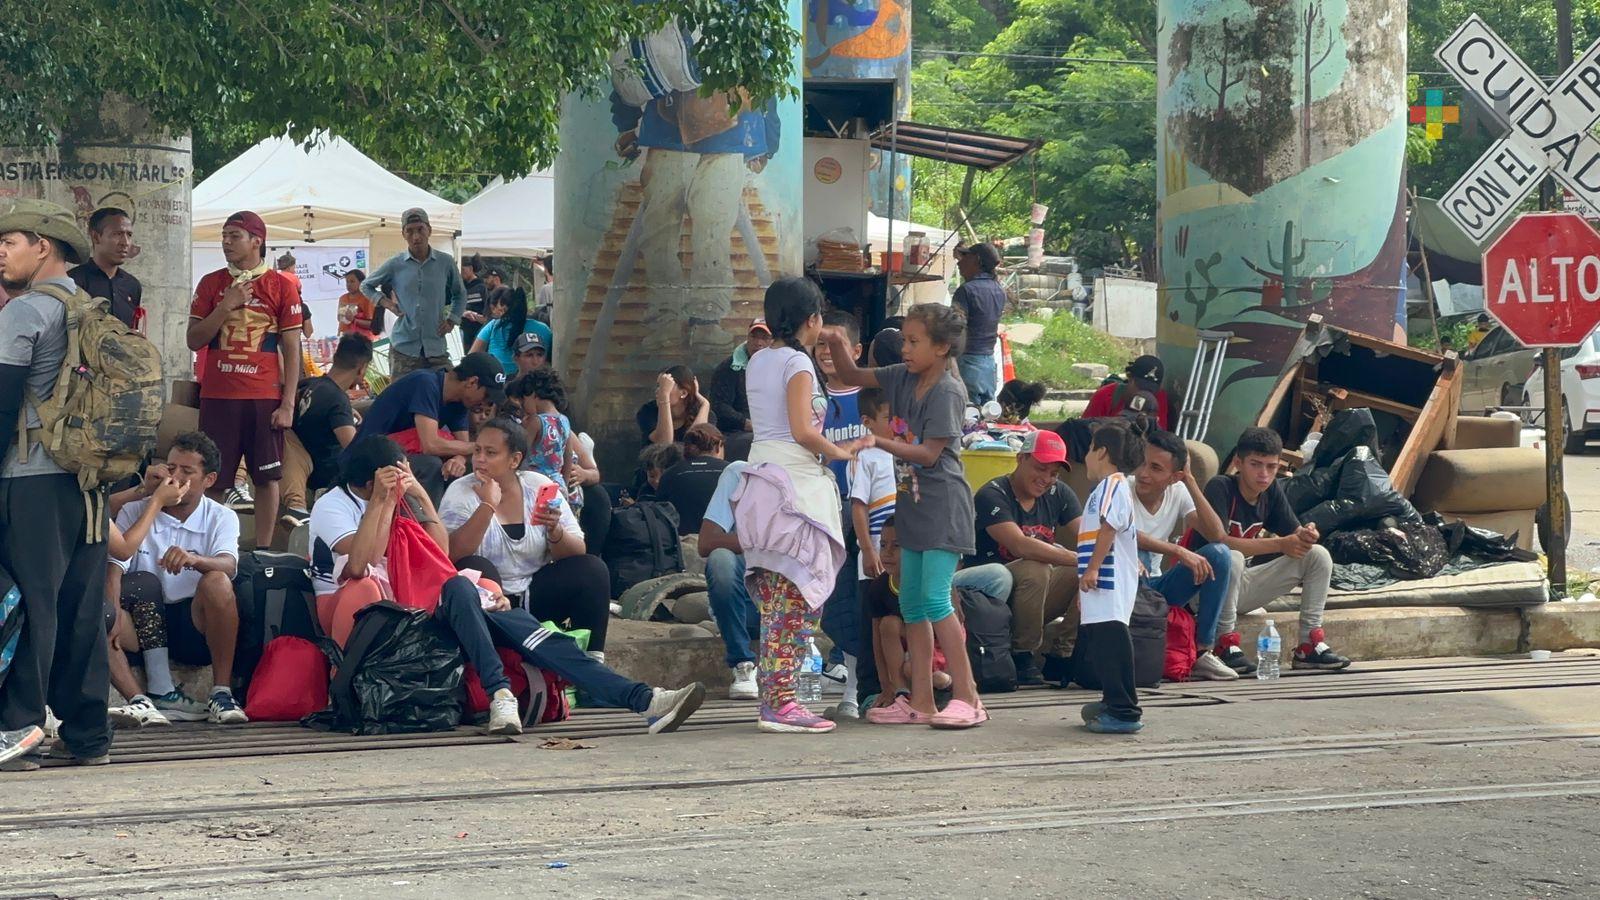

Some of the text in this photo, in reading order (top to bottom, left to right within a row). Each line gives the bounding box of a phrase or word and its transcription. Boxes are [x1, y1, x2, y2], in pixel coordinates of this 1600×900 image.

[1453, 169, 1511, 230] CON
[1494, 147, 1538, 187] EL
[1497, 255, 1600, 304] ALTO
